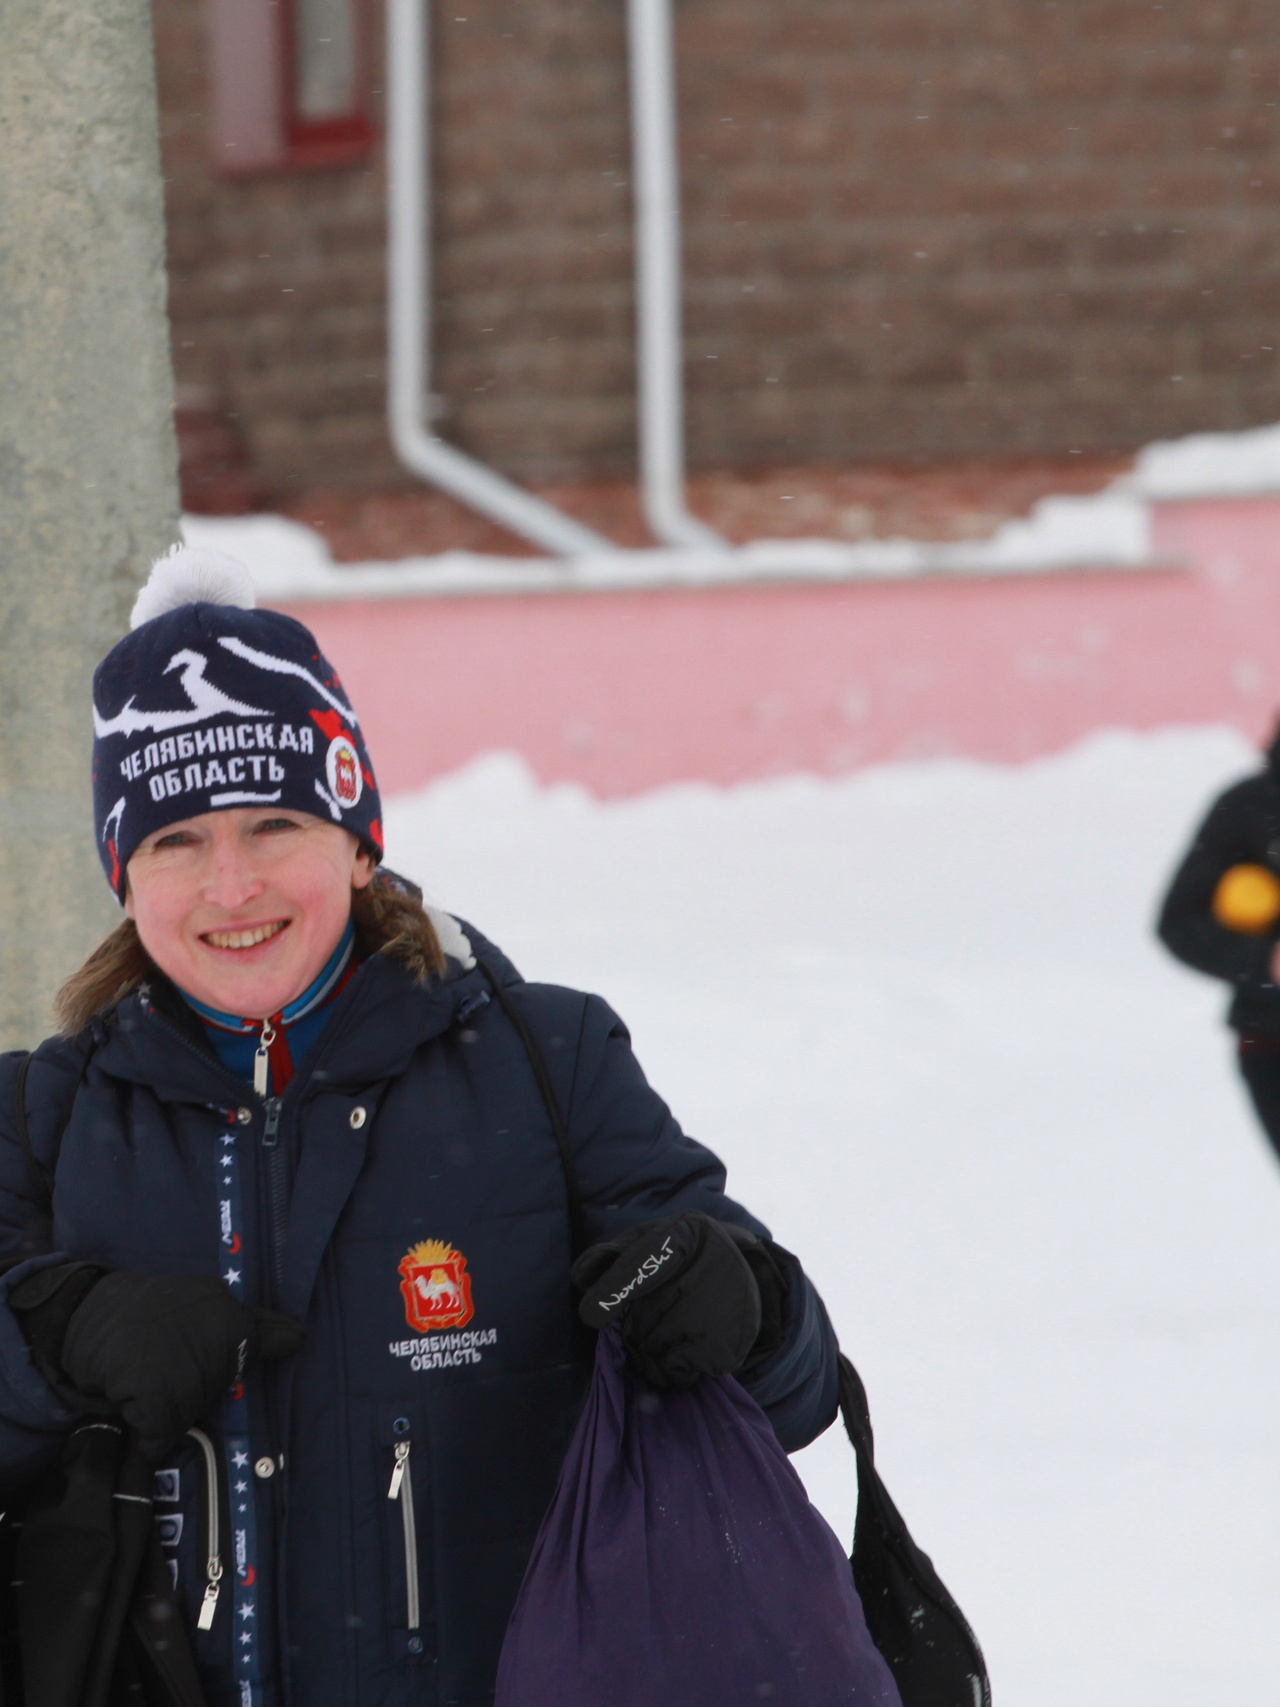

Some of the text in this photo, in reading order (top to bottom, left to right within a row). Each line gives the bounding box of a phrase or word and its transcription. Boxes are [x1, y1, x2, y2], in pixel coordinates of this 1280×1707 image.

[120, 723, 314, 782] ЧЕЛЯБИНСКАЯ
[148, 755, 285, 802] ОБЛАСТЬ
[388, 1328, 498, 1358] ЧЕЛЯБИНСКАЯ
[410, 1348, 482, 1372] ОБЛАСТЬ
